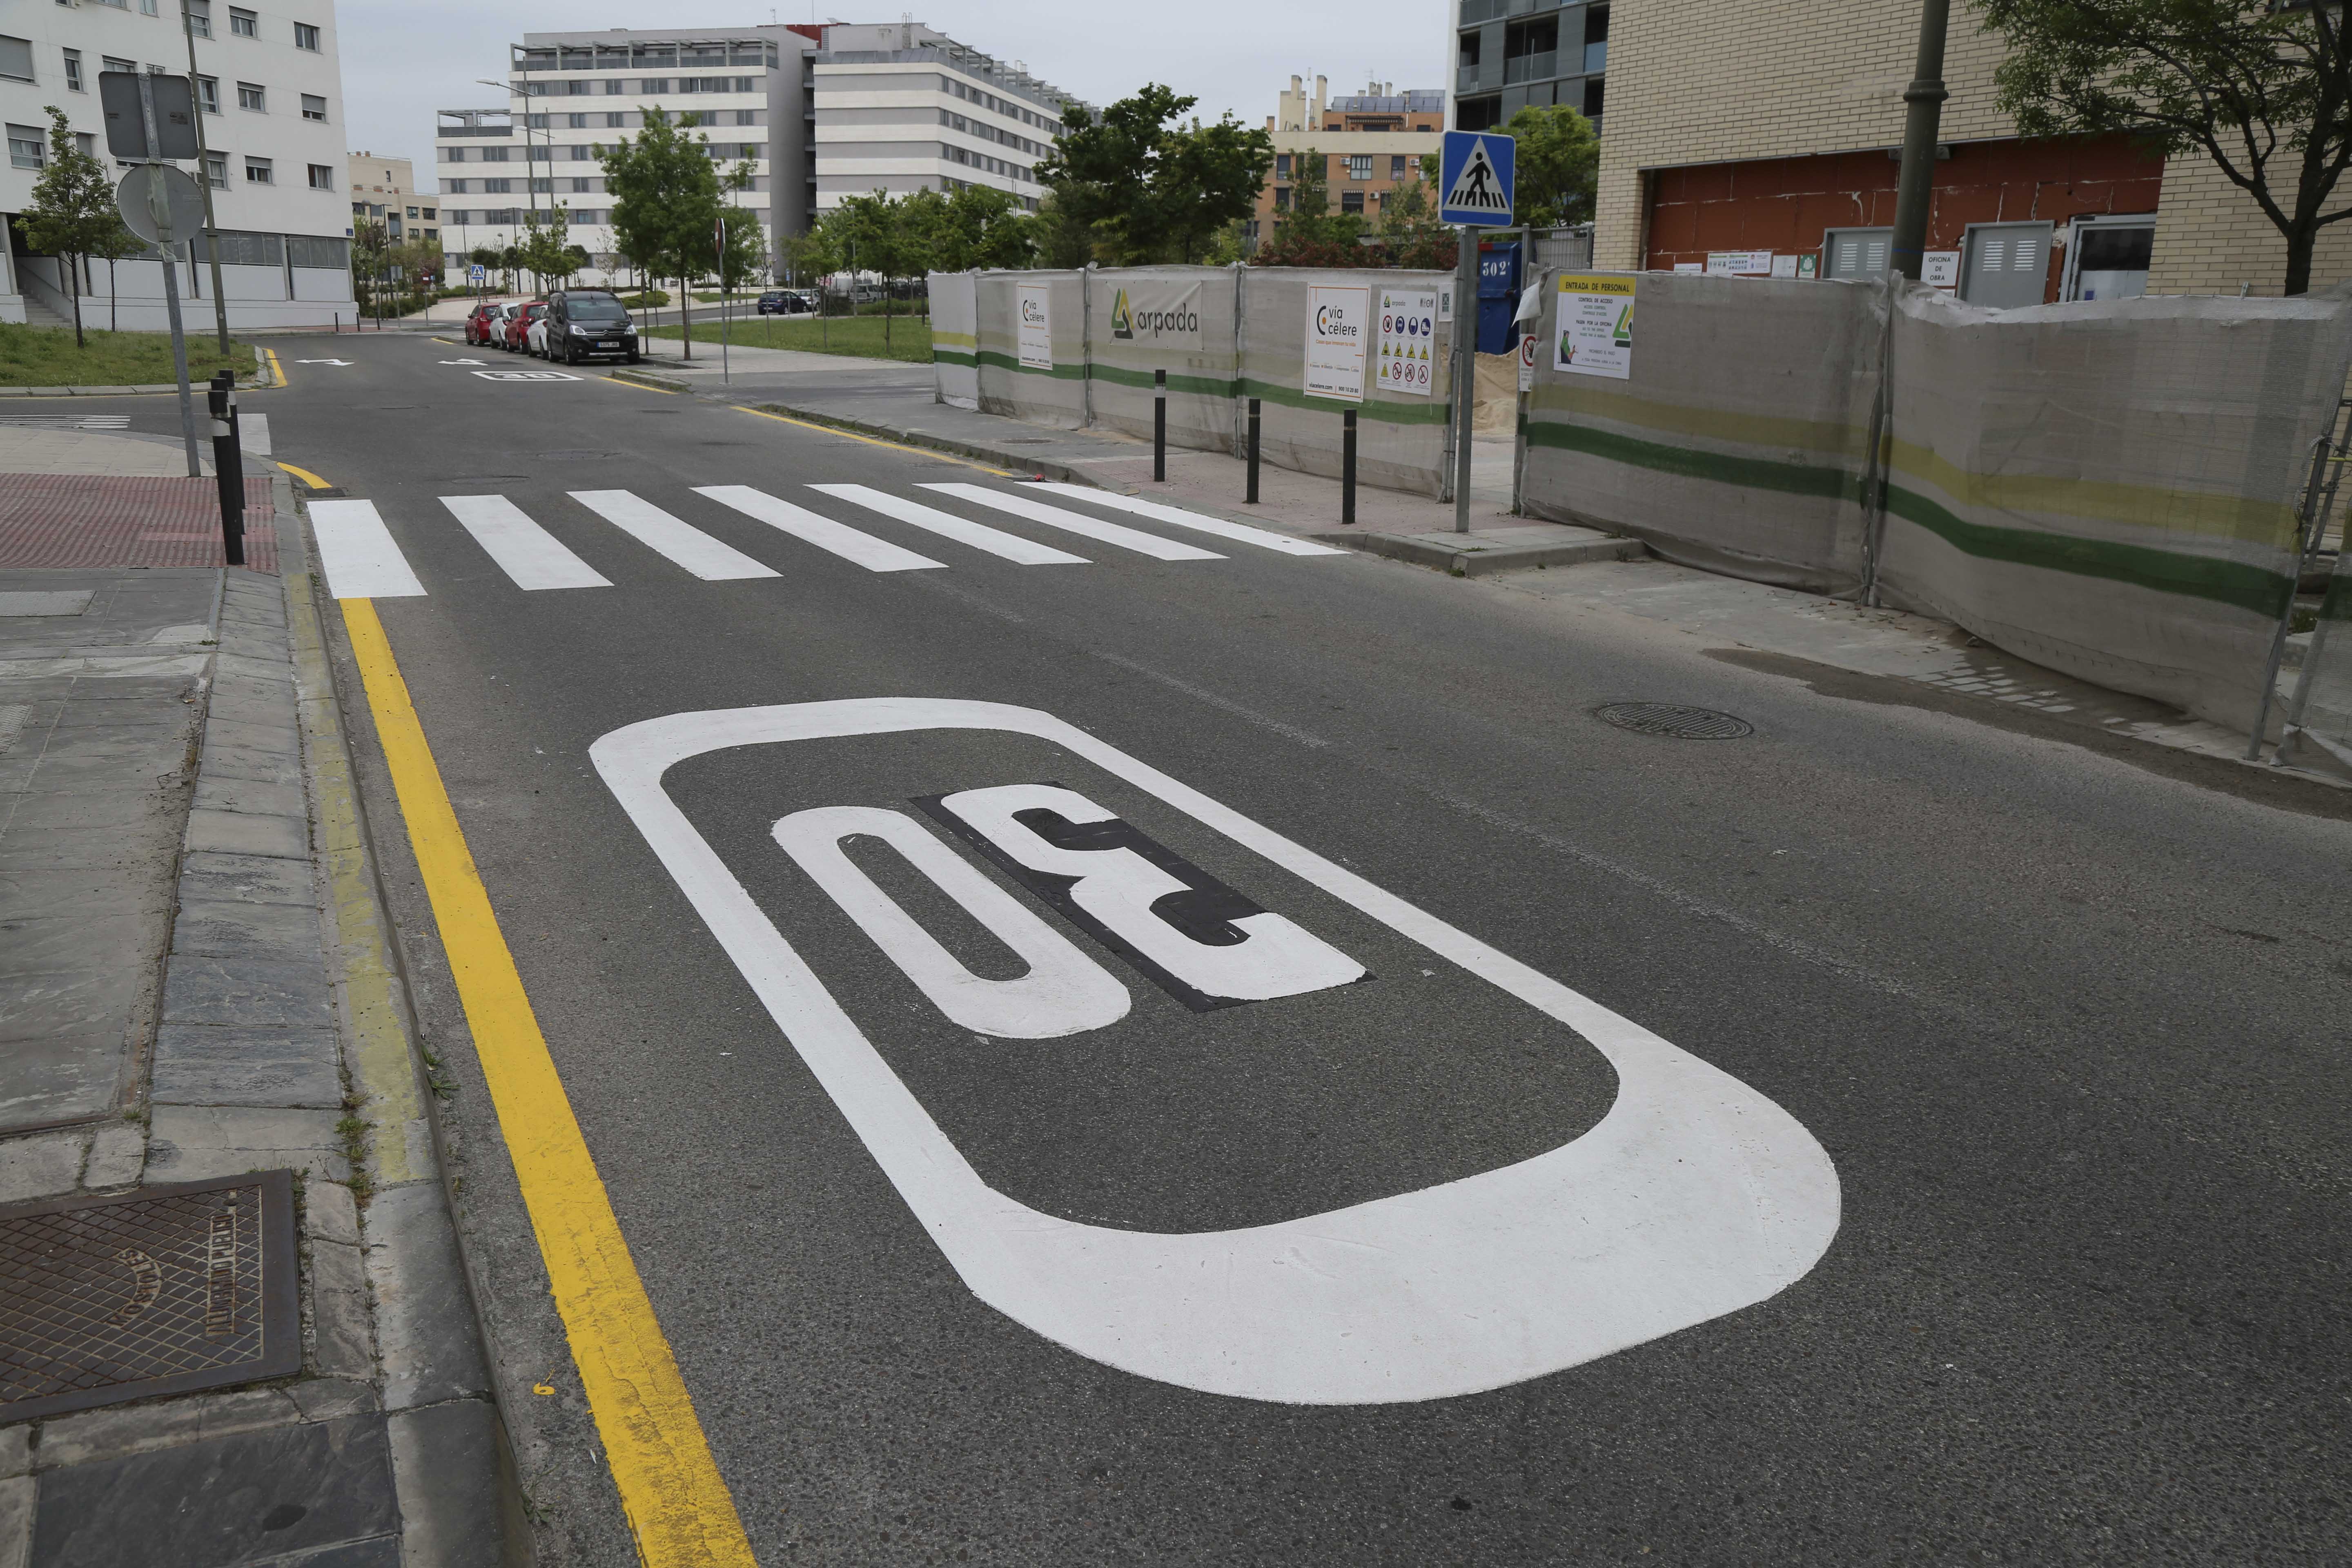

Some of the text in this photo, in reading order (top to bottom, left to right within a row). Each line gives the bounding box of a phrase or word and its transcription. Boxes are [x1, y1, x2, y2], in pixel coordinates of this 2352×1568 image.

[1483, 261, 1510, 276] 302
[1566, 282, 1588, 290] ENTRADA
[1601, 283, 1629, 292] PERSONAL
[1029, 312, 1045, 322] célere
[1329, 305, 1343, 318] vía
[1138, 303, 1197, 338] arpada
[1328, 321, 1357, 336] célere
[1309, 382, 1333, 390] viacelere.com
[771, 783, 1366, 1040] 30
[207, 1214, 234, 1332] ALUMBRADO PUBLICO
[105, 1249, 159, 1326] MOSTOLES
